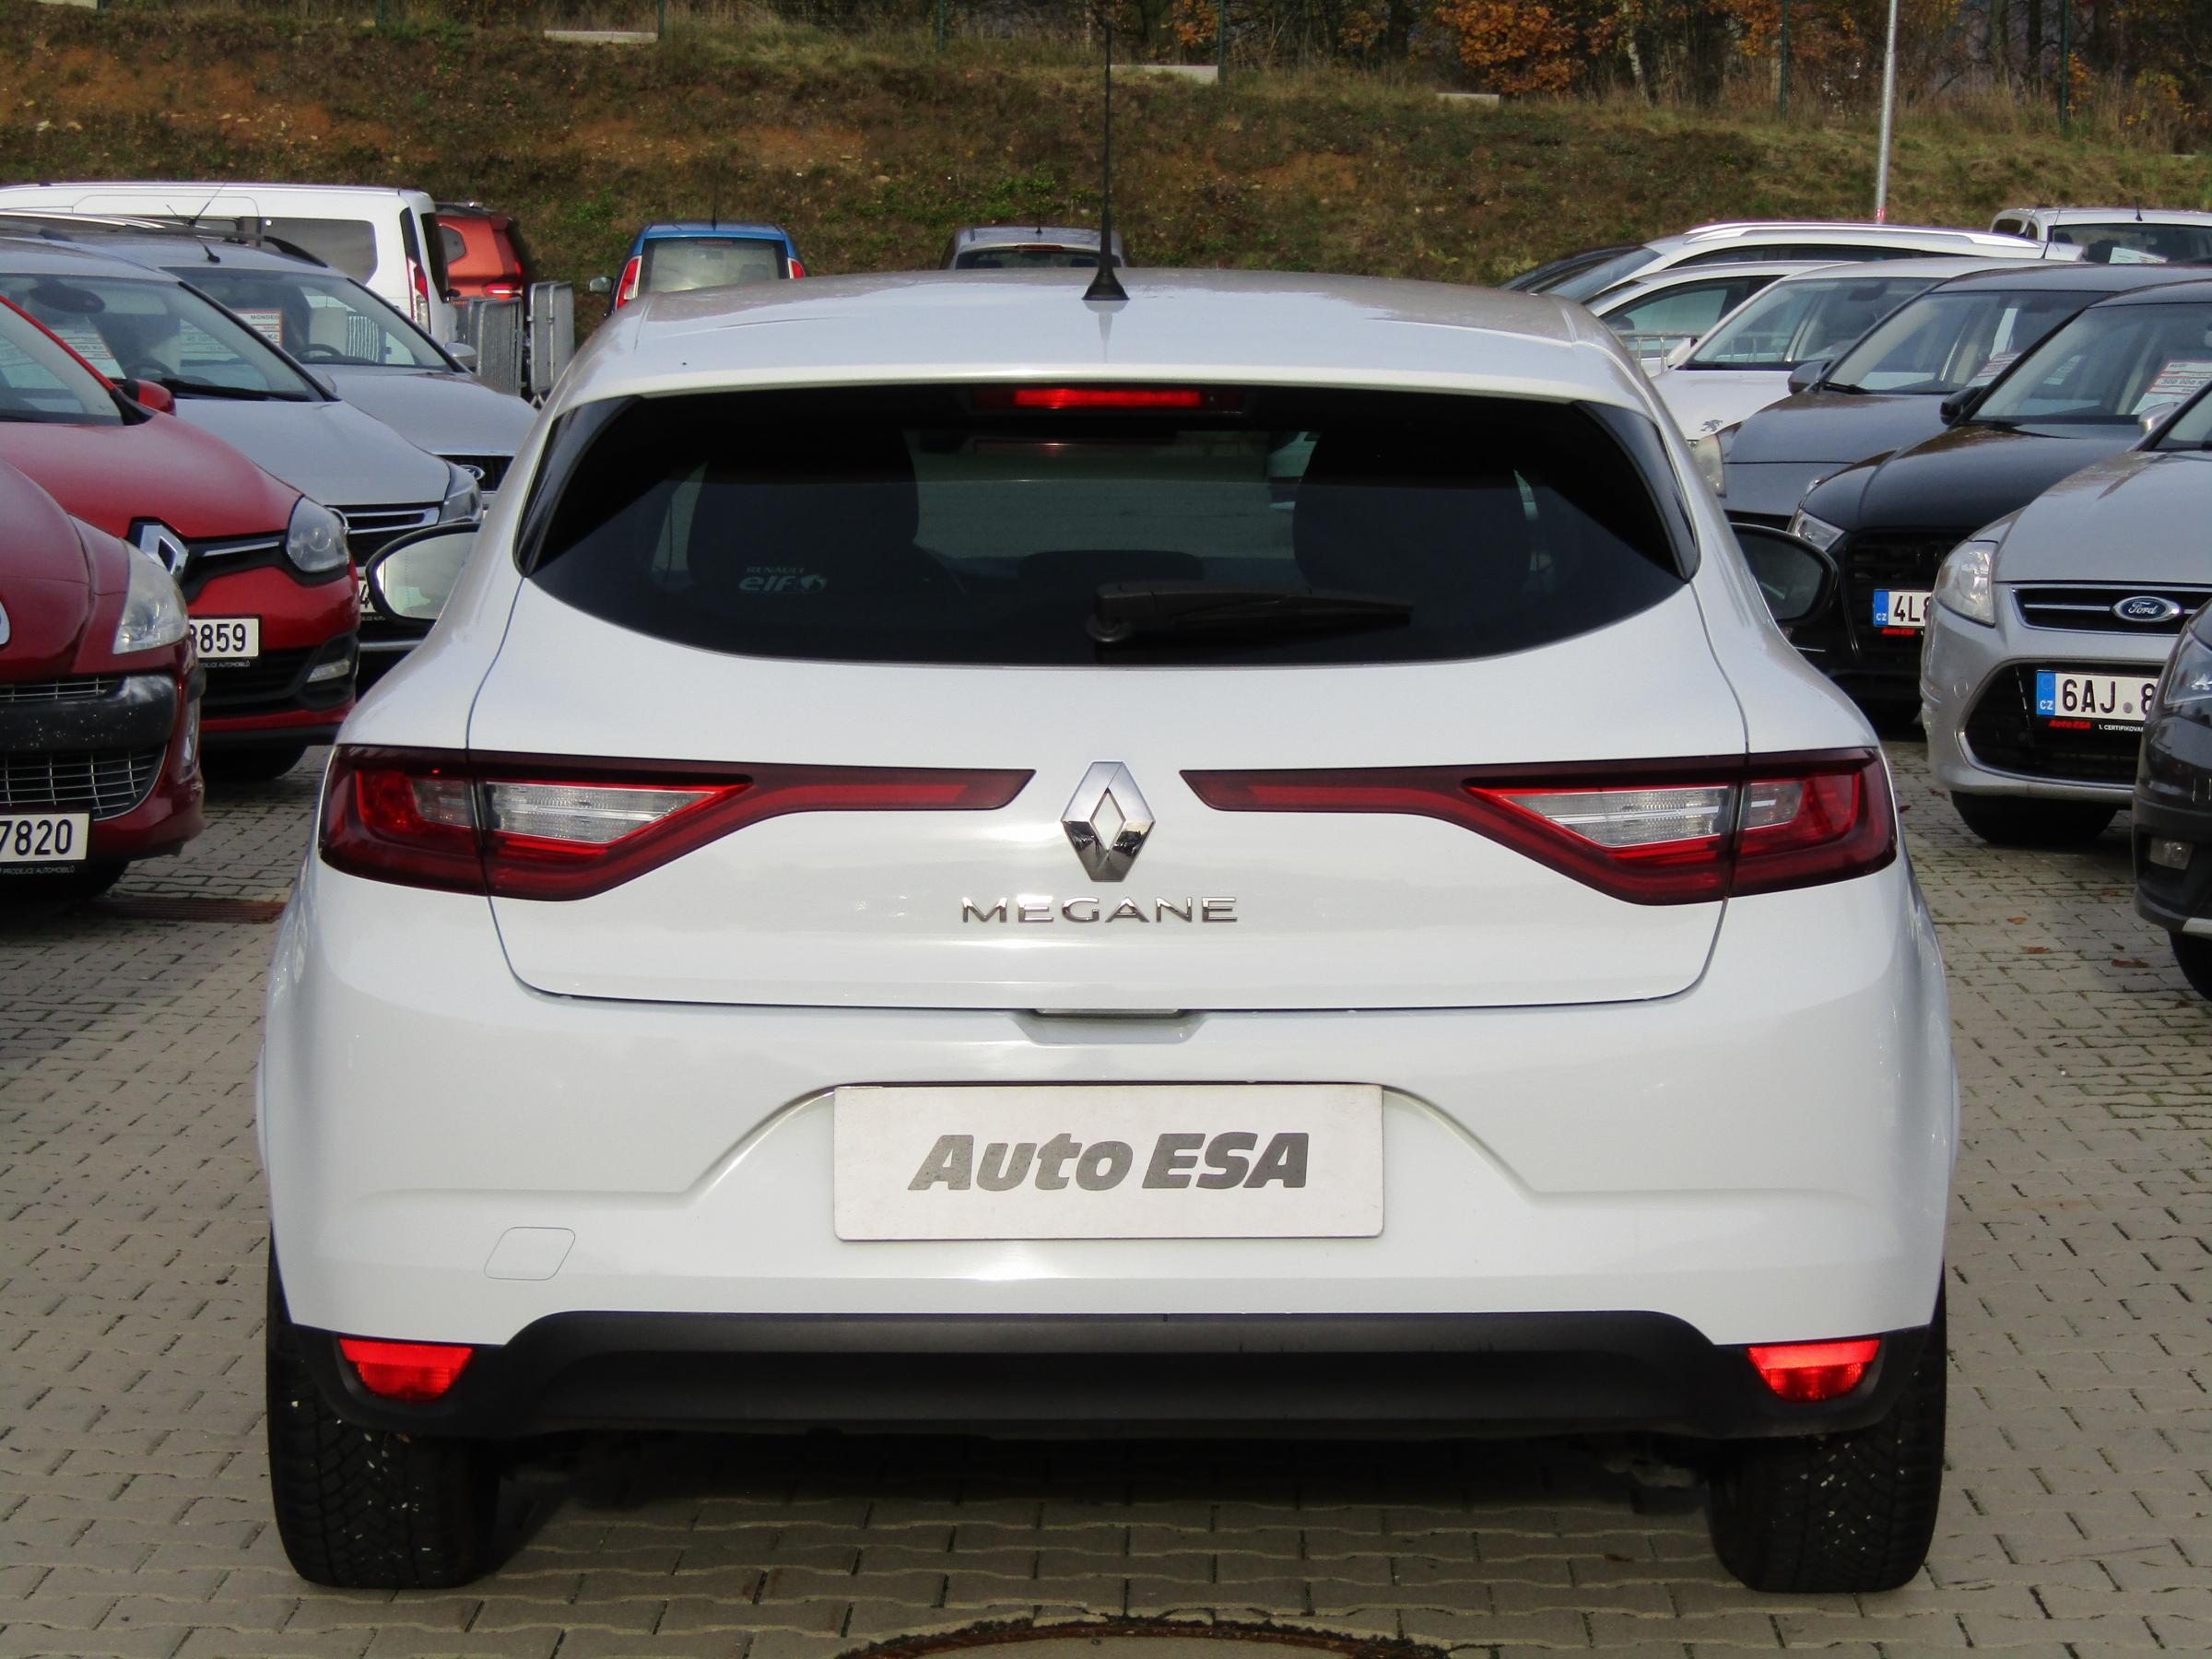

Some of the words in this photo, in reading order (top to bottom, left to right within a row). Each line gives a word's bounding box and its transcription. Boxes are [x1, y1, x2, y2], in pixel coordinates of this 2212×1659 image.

[746, 566, 805, 574] RENAULT
[2128, 601, 2159, 615] Ford
[1876, 613, 1887, 621] CZ
[2040, 700, 2053, 711] CZ
[962, 896, 1238, 923] MEGANE
[907, 1133, 1134, 1192] Auto
[1141, 1131, 1310, 1190] ESA
